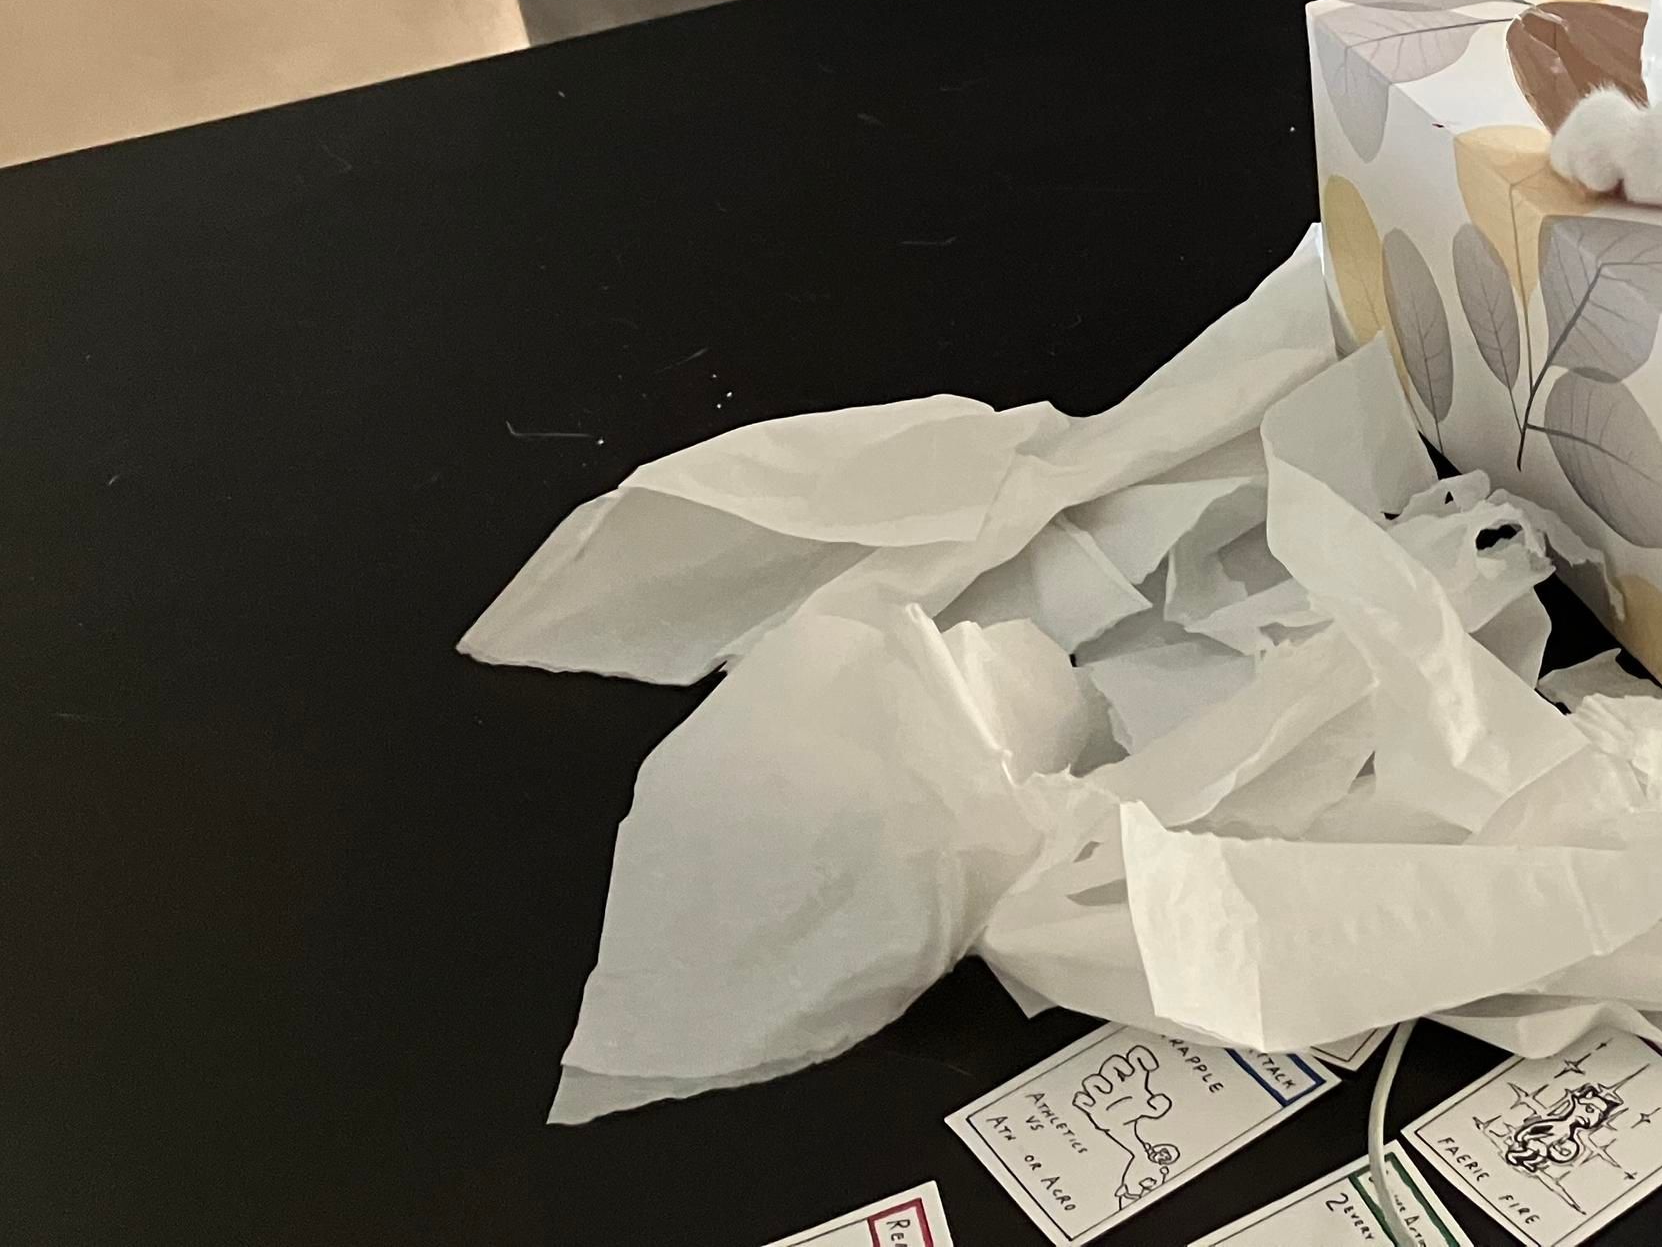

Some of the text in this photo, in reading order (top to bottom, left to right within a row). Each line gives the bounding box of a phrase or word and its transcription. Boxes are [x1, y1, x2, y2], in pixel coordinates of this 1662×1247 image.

[1161, 1034, 1224, 1093] RAPPLE
[1249, 1048, 1297, 1089] TTACK
[1025, 1115, 1045, 1131] VS
[1025, 1093, 1088, 1154] ATHLETICS
[1024, 1154, 1042, 1171] OR
[1040, 1176, 1077, 1211] ACRO
[1437, 1137, 1541, 1224] FAERIE FIRE
